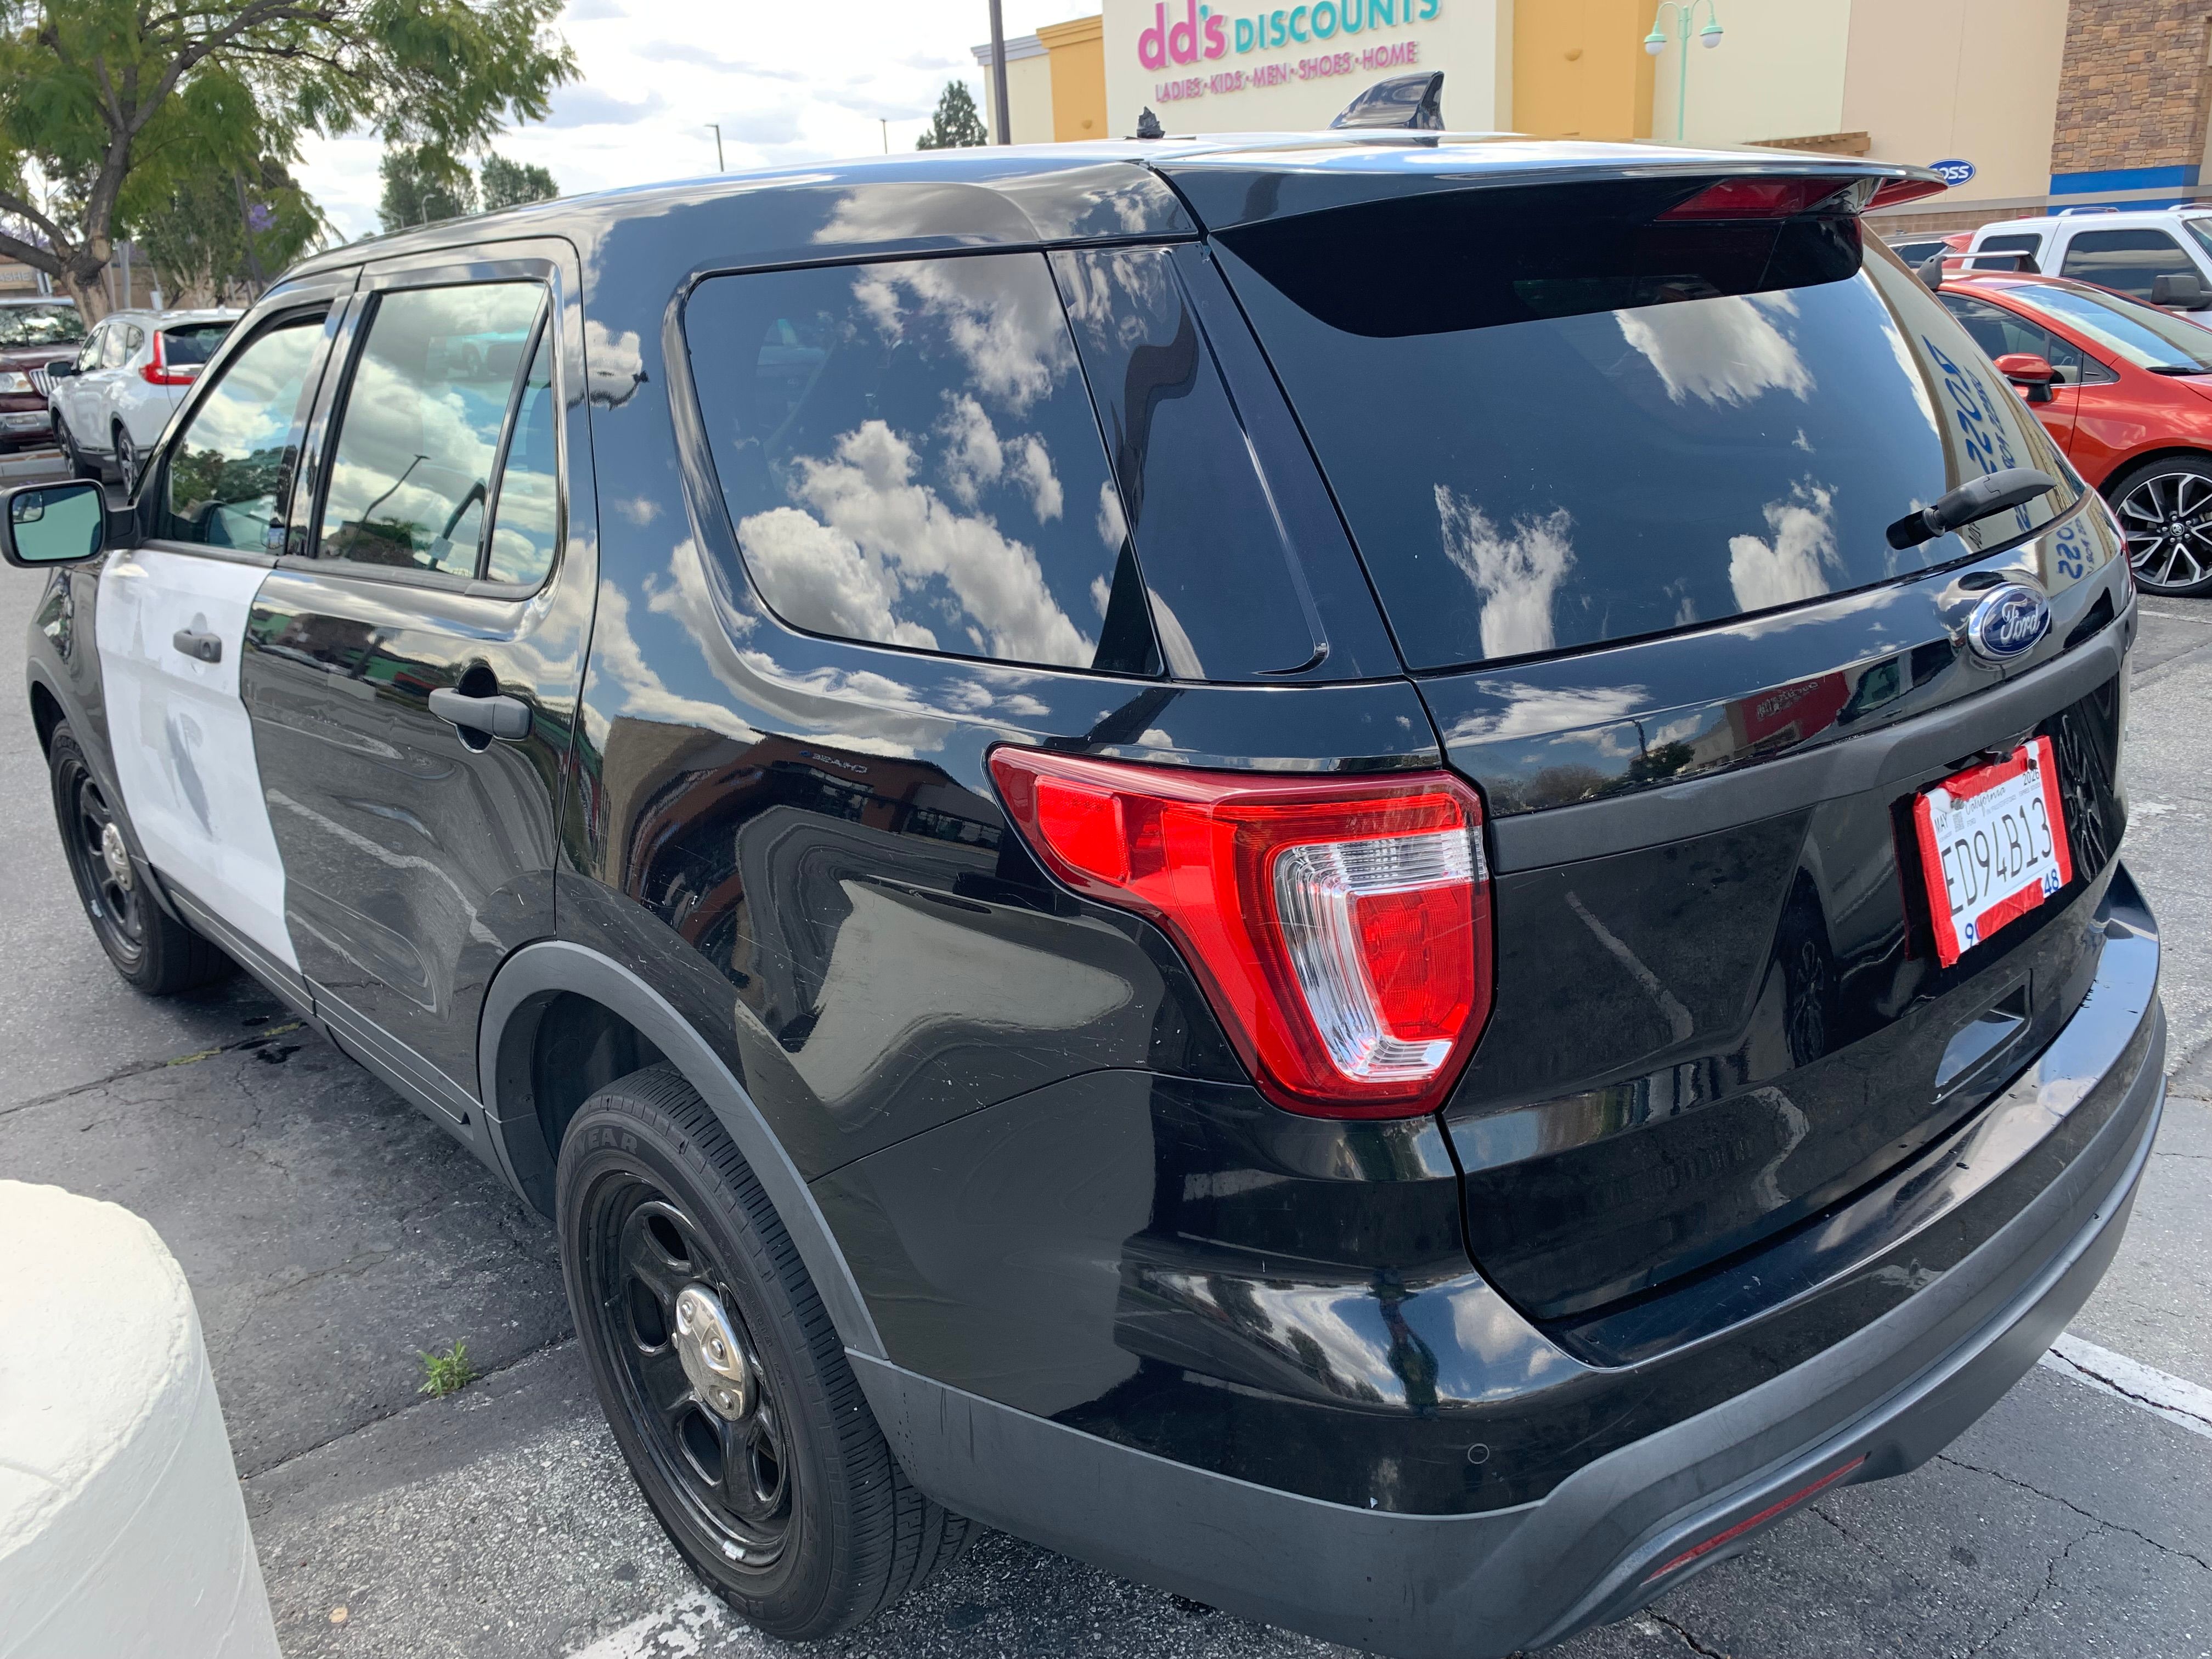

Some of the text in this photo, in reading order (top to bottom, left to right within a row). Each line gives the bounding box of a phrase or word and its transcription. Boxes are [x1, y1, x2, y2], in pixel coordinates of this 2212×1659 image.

[1138, 0, 1227, 70] dd's
[1155, 41, 1418, 103] LADIES KIDS MEN SHOES HOME
[1929, 166, 1970, 179] OSS
[2001, 598, 2040, 644] Ford
[2023, 769, 2040, 786] 2026
[1964, 788, 2006, 817] California
[1934, 812, 1948, 833] MAY
[1941, 797, 2053, 916] ED94B13
